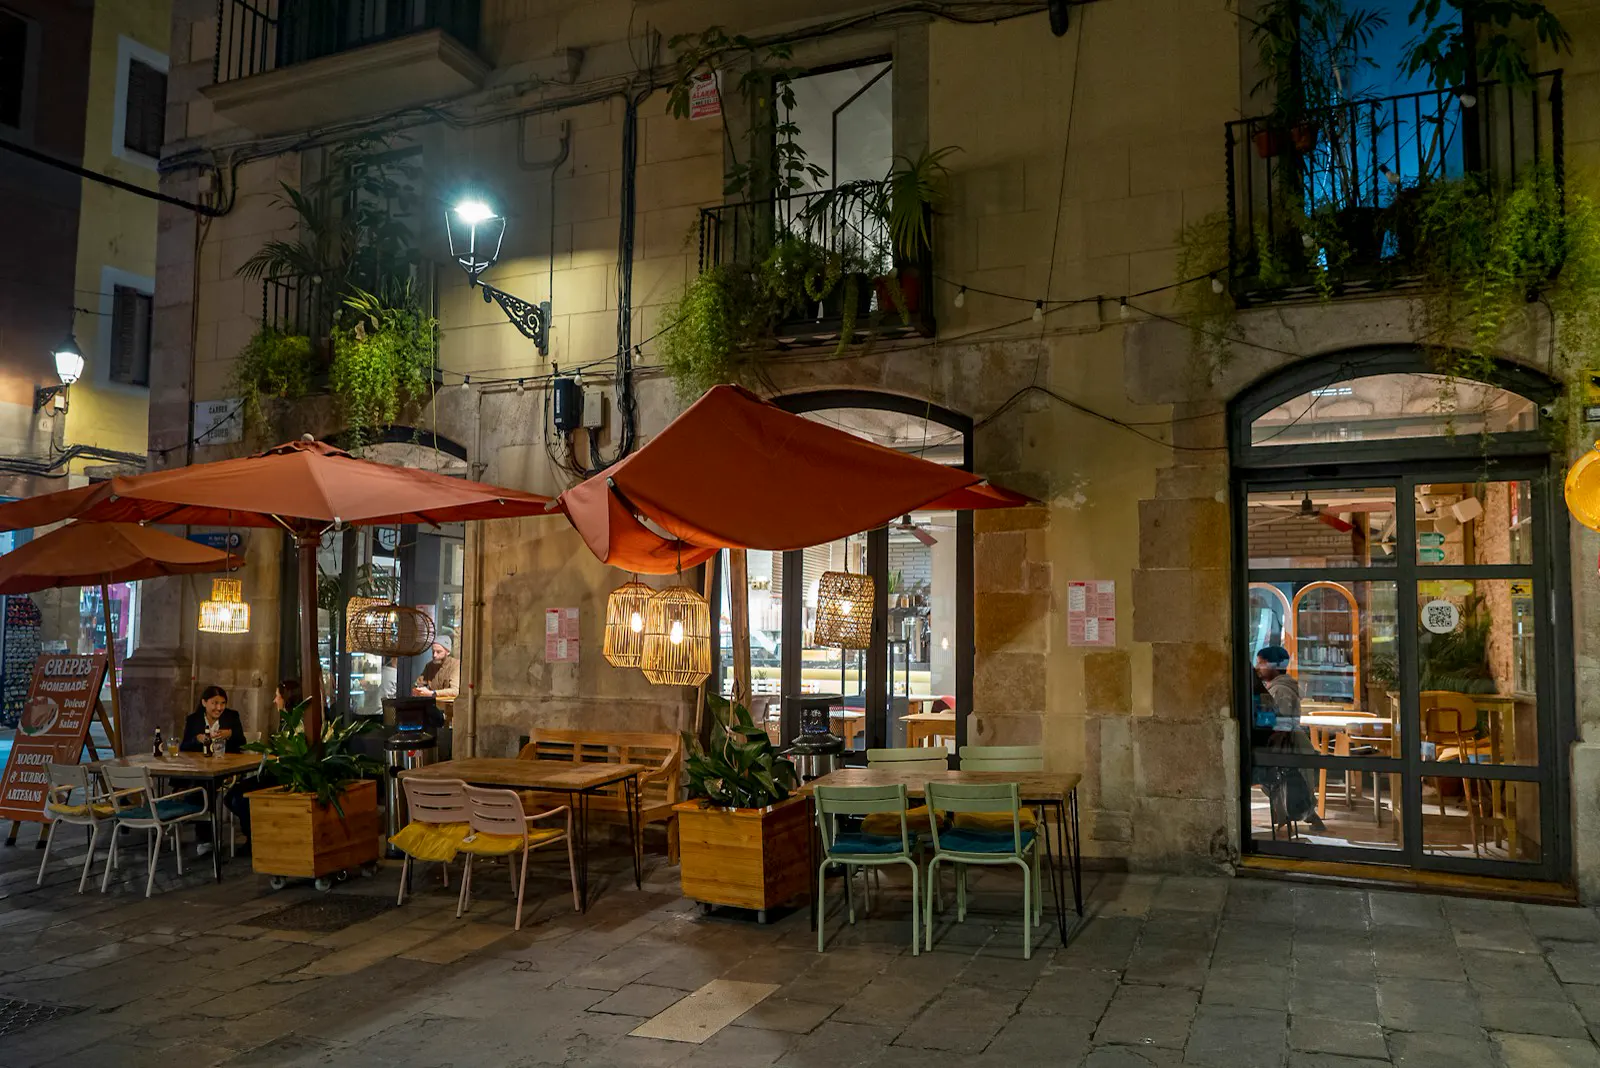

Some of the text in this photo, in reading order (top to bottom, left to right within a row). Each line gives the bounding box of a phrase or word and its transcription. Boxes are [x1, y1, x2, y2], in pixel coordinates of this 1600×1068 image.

[44, 658, 93, 676] CREPES
[40, 680, 88, 692] HOMEMADE
[6, 788, 43, 802] ARTESANS
